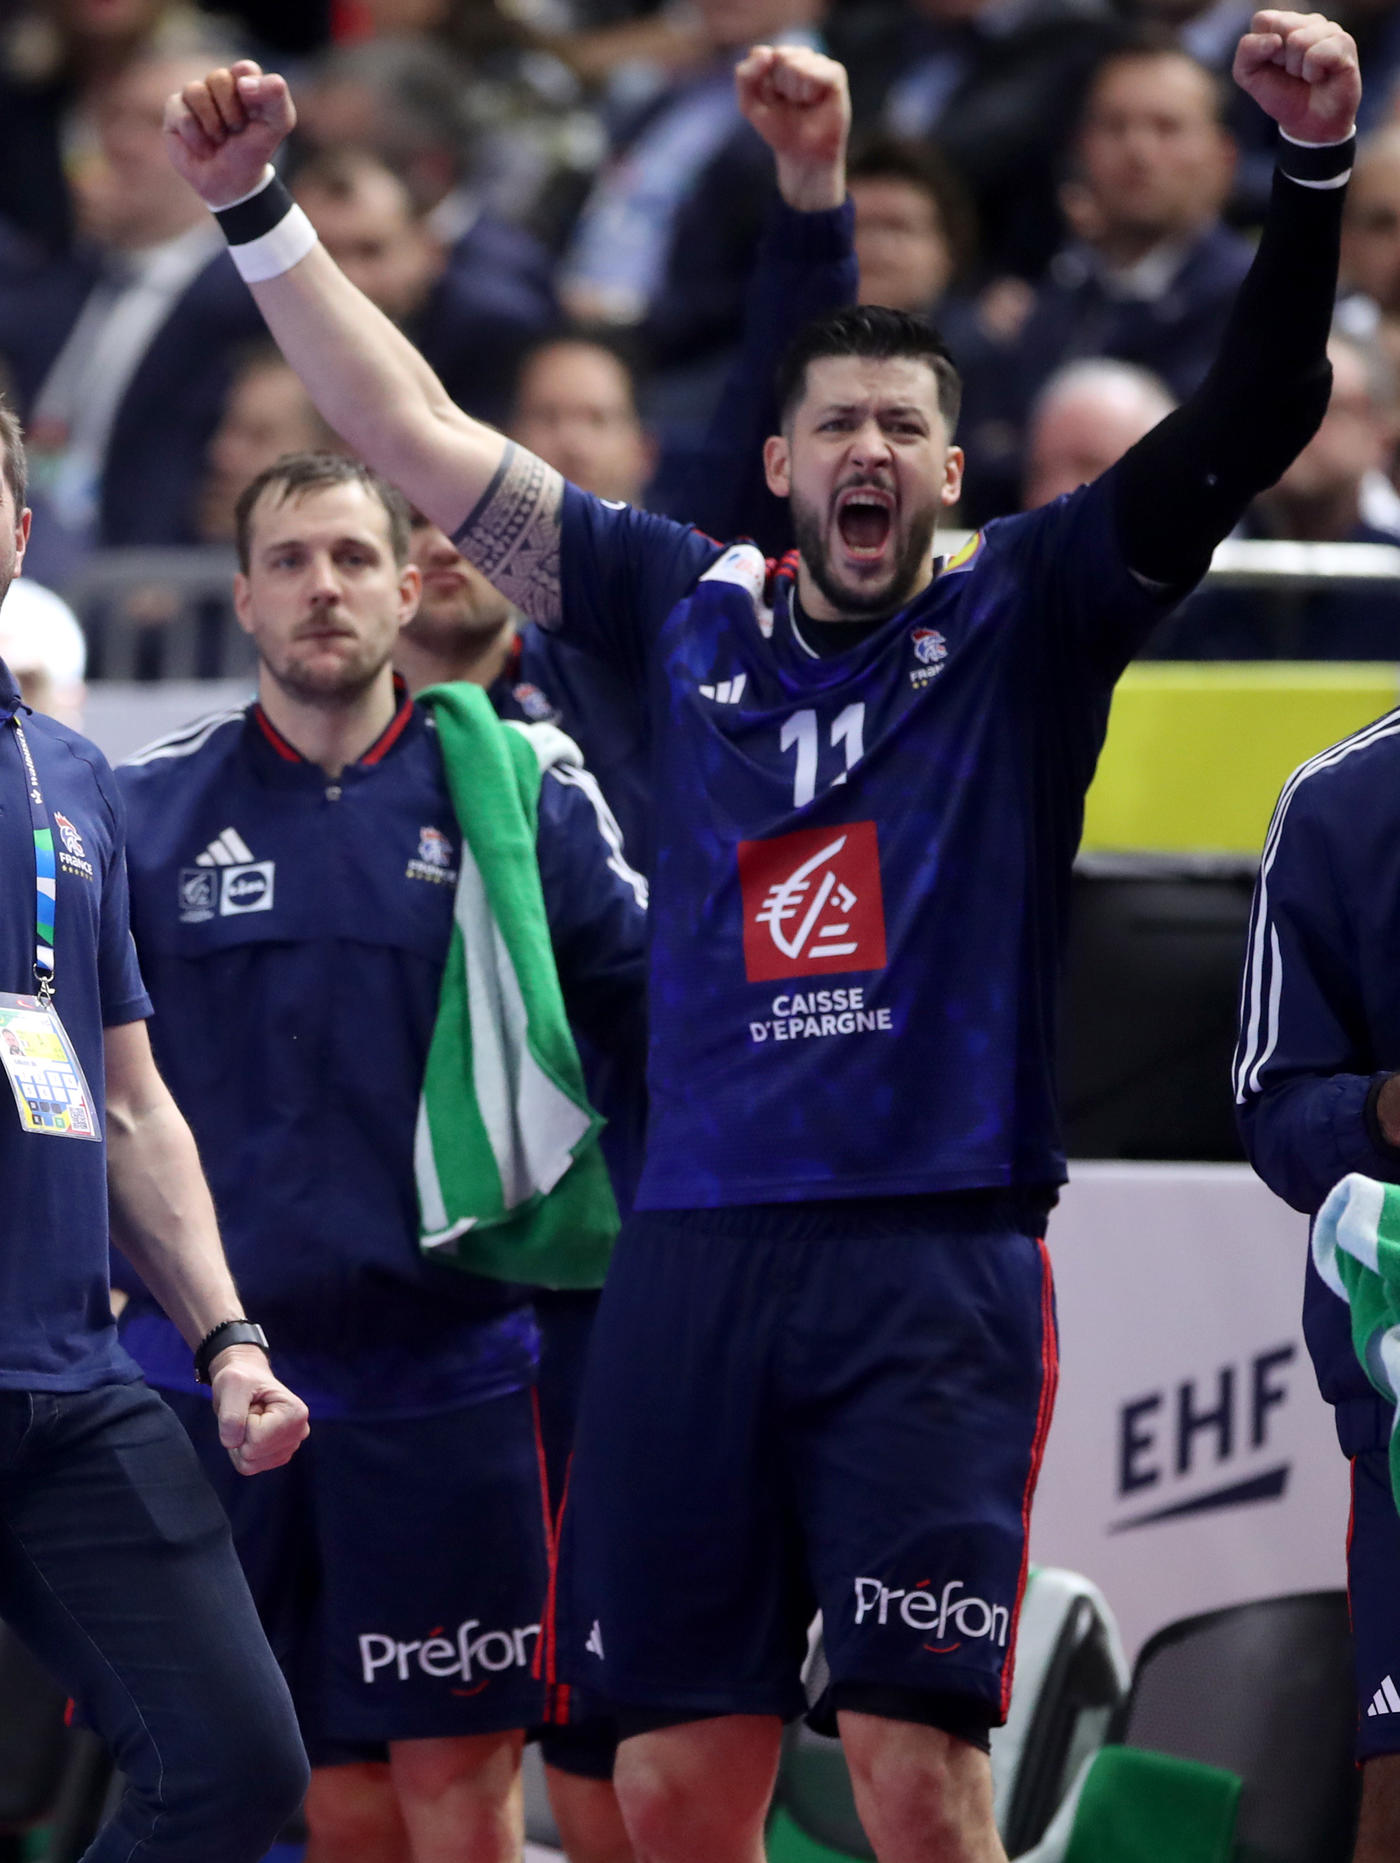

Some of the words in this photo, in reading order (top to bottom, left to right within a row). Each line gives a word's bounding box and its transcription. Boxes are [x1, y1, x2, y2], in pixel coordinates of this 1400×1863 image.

[780, 702, 866, 808] 11
[749, 1009, 893, 1043] D'EPARGNE
[772, 988, 865, 1019] CAISSE
[1117, 1342, 1297, 1498] EHF
[854, 1577, 1010, 1647] Préfon
